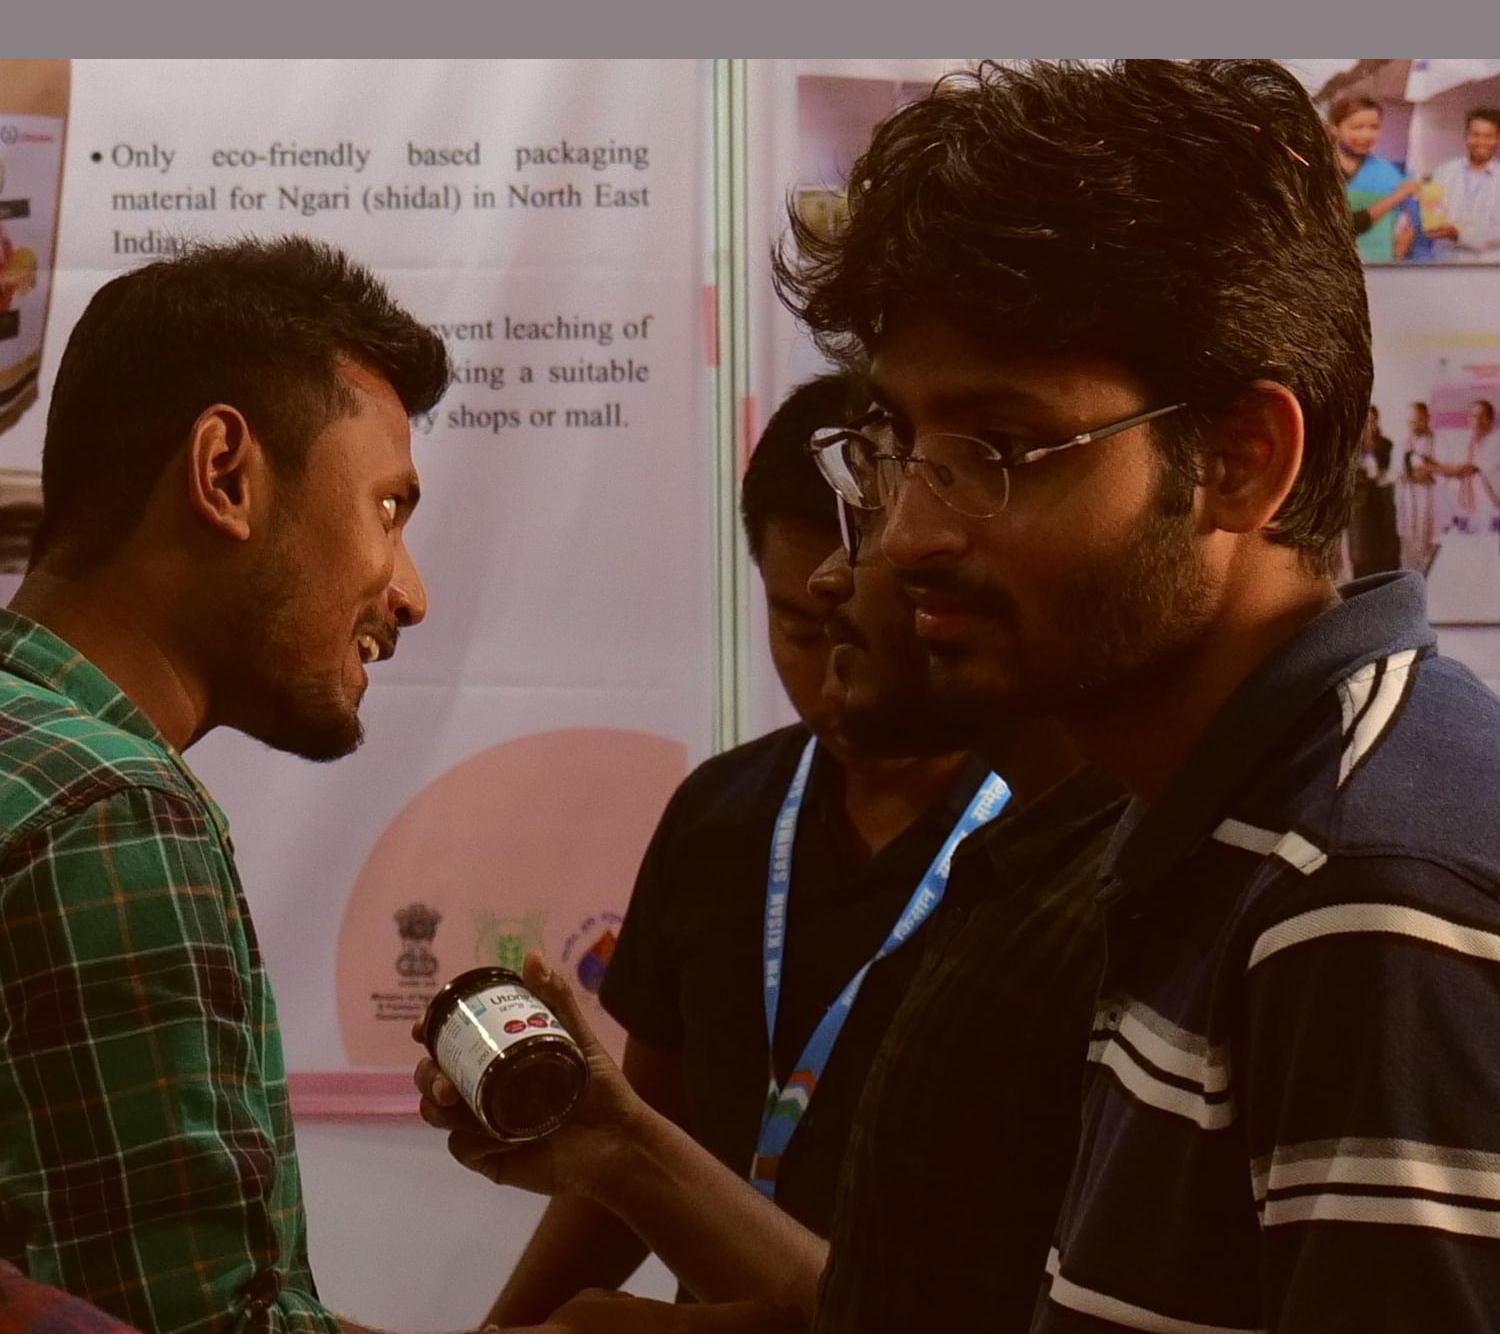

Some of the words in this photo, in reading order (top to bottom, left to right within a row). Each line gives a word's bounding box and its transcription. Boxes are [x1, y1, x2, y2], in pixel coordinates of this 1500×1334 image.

[112, 142, 176, 172] Only
[212, 141, 371, 173] eco-friendly
[407, 141, 481, 167] based
[514, 141, 650, 171] packaging
[112, 186, 217, 212] material
[229, 185, 266, 211] for
[277, 186, 350, 216] Ngari
[362, 184, 462, 214] (shidal)
[473, 185, 496, 210] in
[508, 184, 582, 210] North
[595, 183, 650, 209] East
[505, 317, 613, 345] leaching
[622, 315, 654, 340] of
[520, 369, 534, 384] a
[549, 360, 650, 384] suitable
[448, 403, 520, 431] shops
[530, 409, 557, 428] or
[565, 403, 629, 428] mall.
